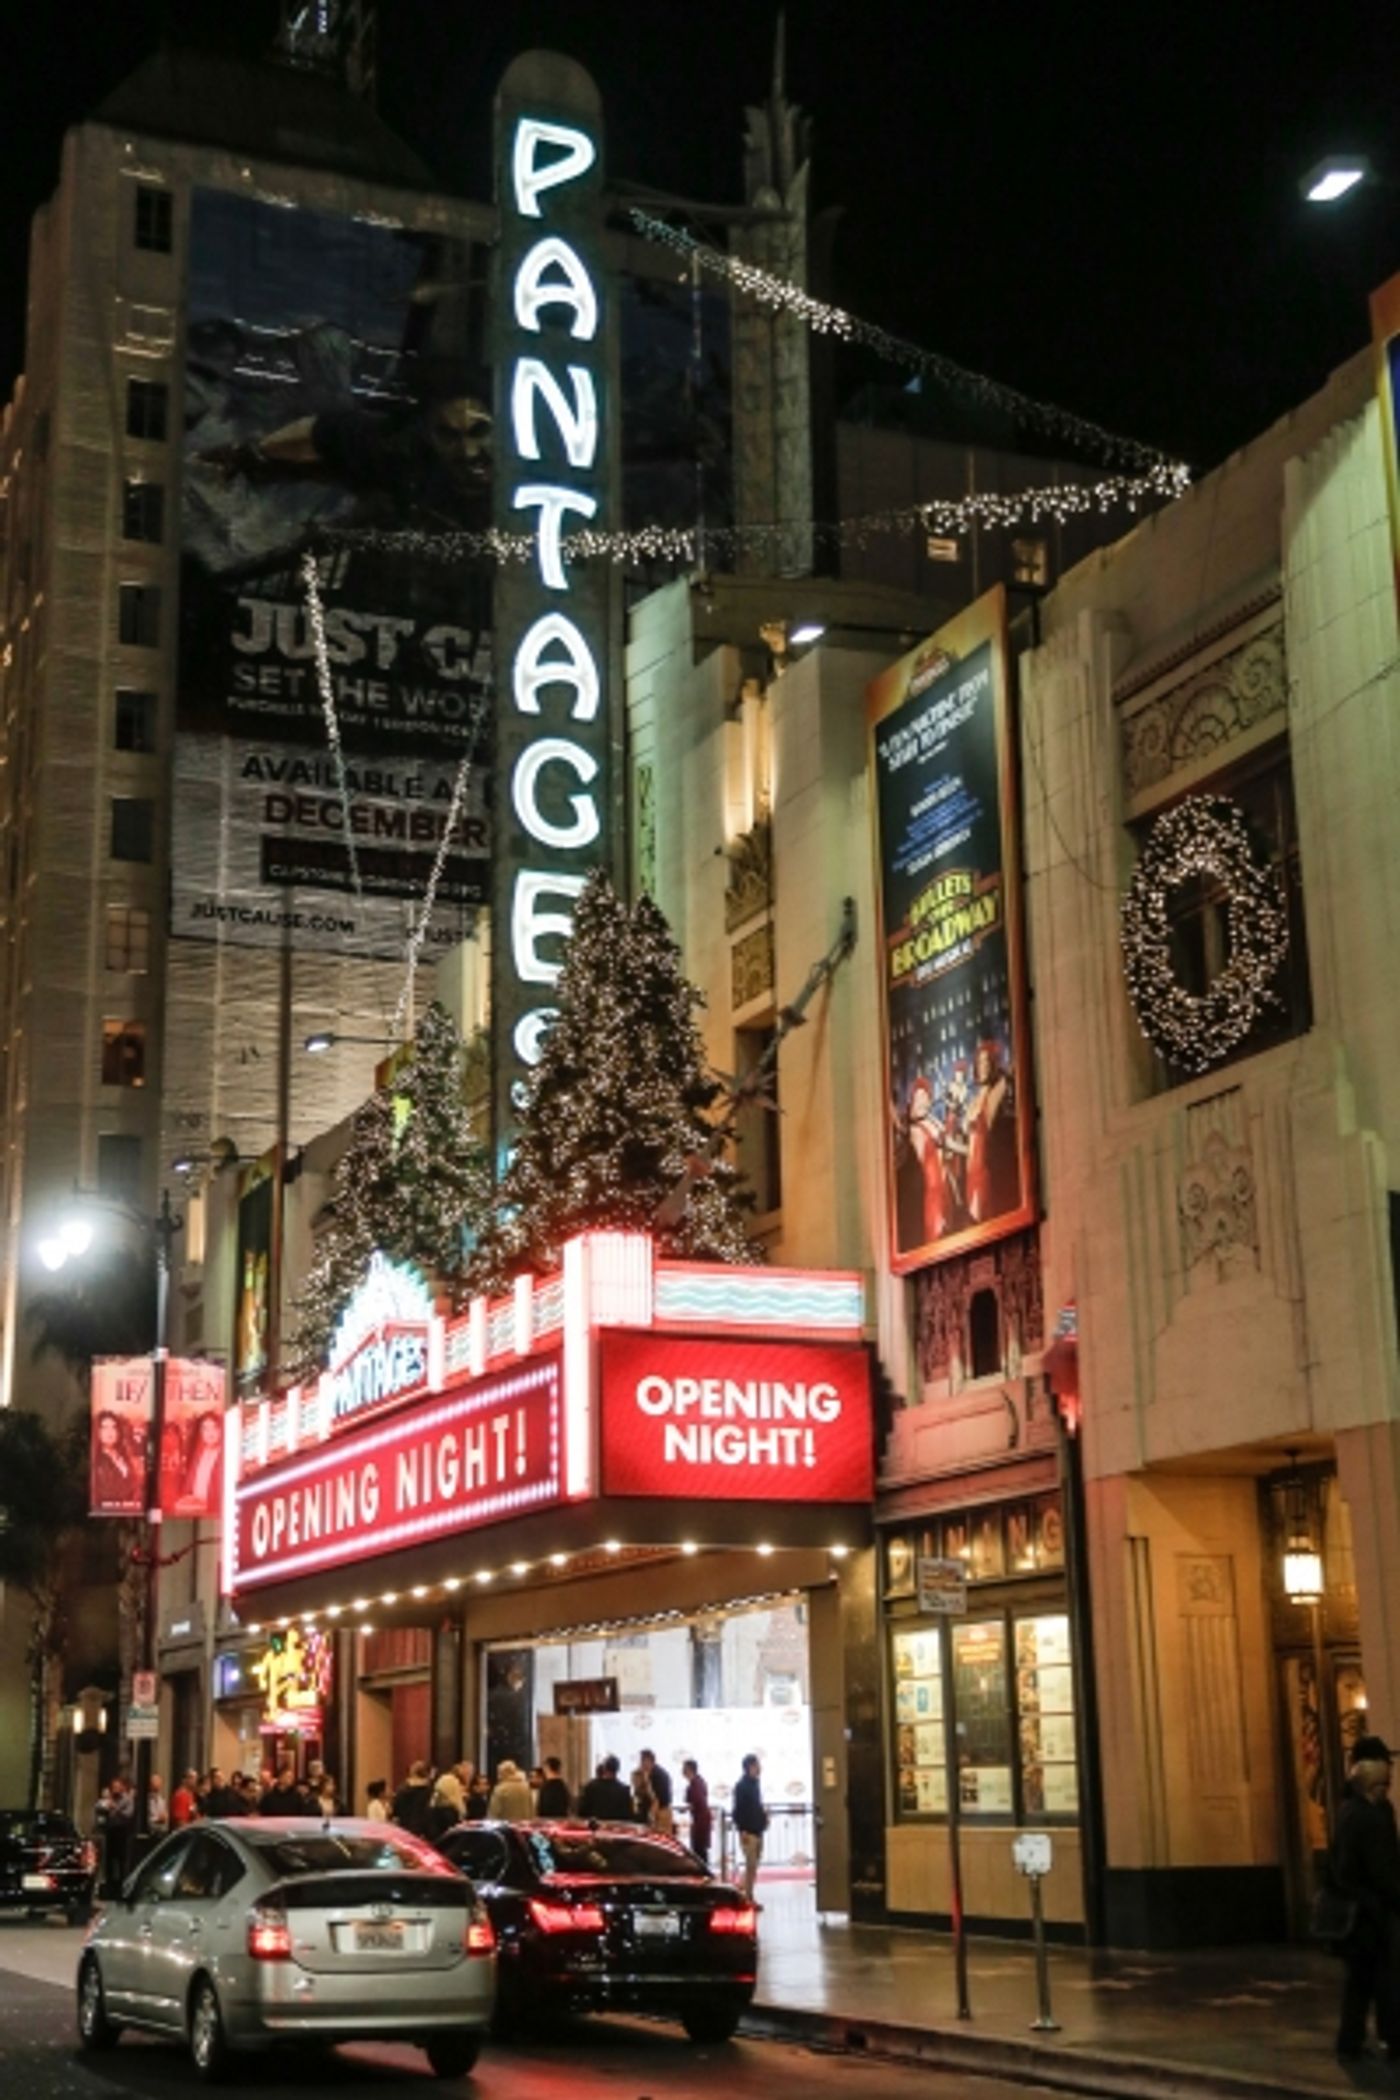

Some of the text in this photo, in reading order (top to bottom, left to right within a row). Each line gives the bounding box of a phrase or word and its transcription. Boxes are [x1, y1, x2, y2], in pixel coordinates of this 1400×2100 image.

[230, 597, 415, 670] JUST
[233, 662, 306, 697] SET
[319, 669, 389, 709] HE
[240, 755, 425, 798] AVAILABLE
[264, 794, 487, 848] DECEMBER
[891, 889, 998, 978] BROADWAY
[636, 1374, 842, 1423] OPENING
[663, 1423, 817, 1468] NIGHT!
[251, 1407, 527, 1558] OPENING NIGHT!
